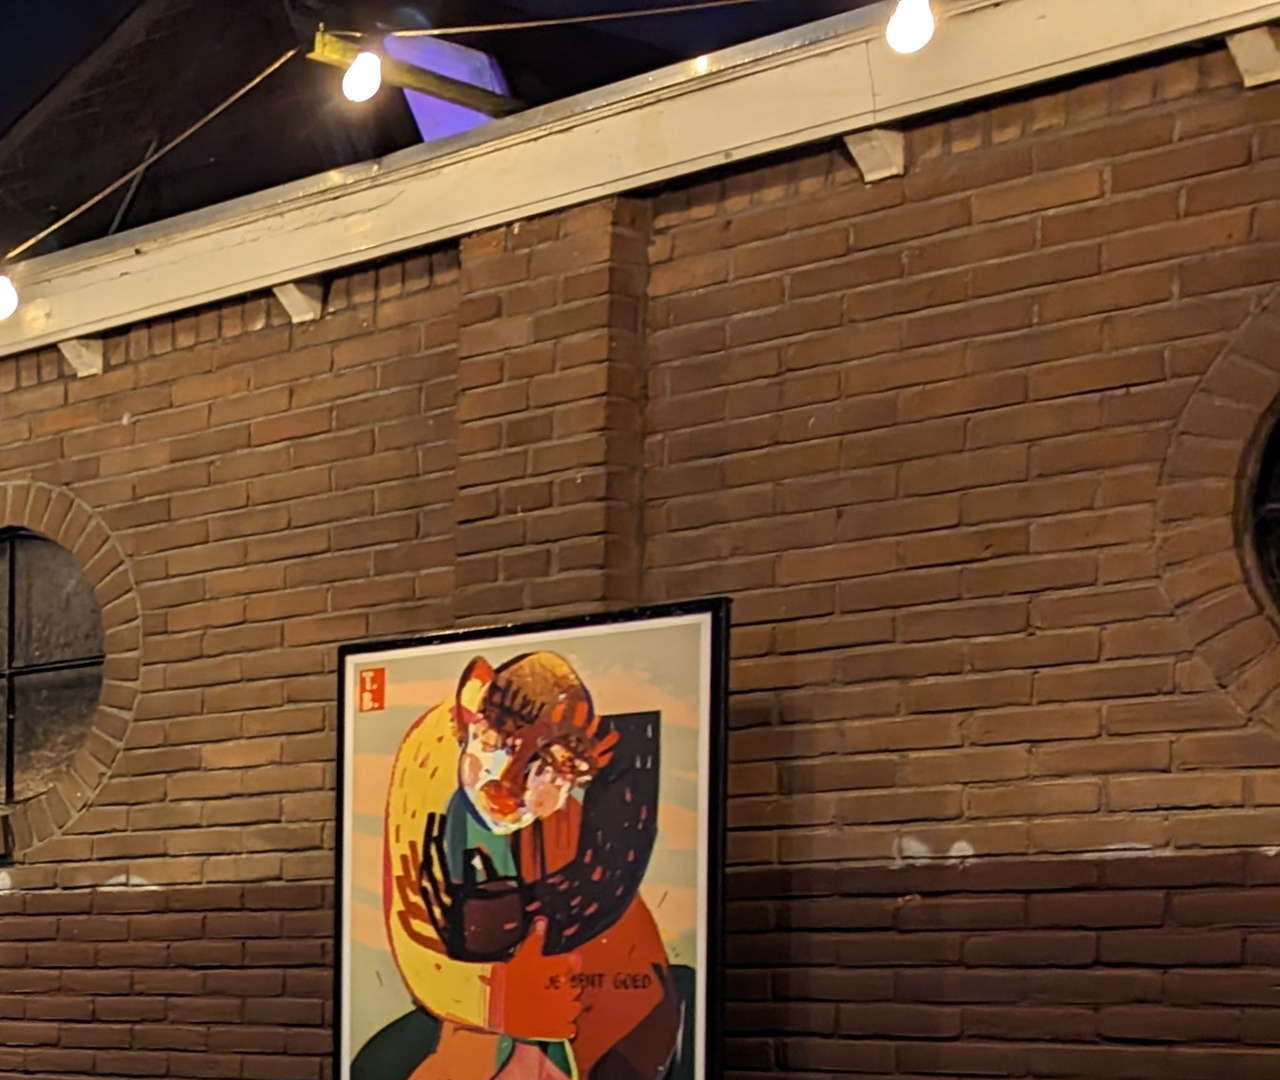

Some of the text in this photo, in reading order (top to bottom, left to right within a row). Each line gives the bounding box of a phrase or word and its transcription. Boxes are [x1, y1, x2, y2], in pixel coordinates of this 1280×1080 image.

[361, 671, 378, 690] T.
[362, 692, 379, 711] B.
[544, 972, 652, 990] JE BENT GOED
